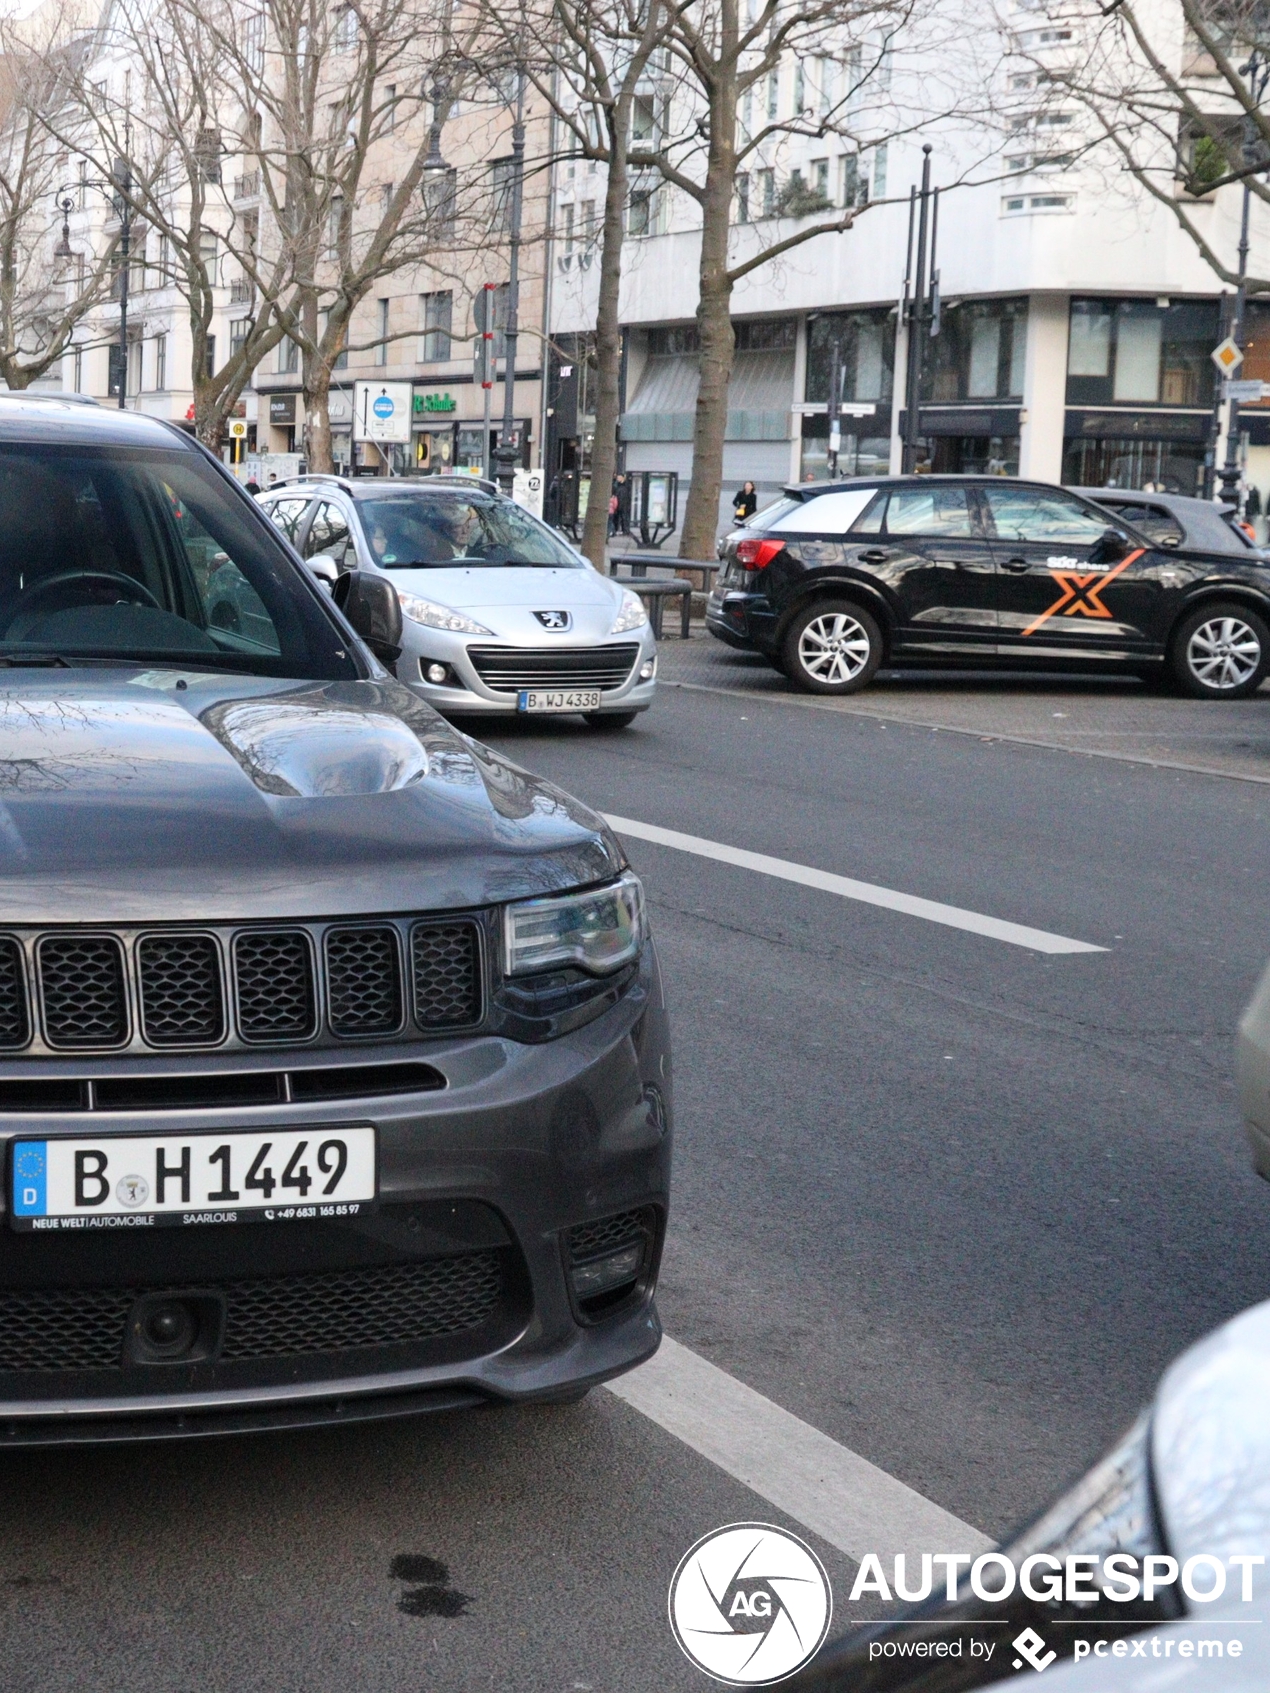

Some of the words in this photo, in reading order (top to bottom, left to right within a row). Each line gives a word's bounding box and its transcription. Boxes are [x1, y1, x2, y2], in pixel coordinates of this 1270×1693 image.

[1077, 561, 1110, 572] share
[528, 694, 537, 707] B
[546, 693, 564, 707] WJ
[566, 692, 599, 706] 4338
[74, 1149, 111, 1207] B
[23, 1188, 37, 1205] D
[277, 1208, 294, 1218] +49
[296, 1207, 316, 1217] 6831
[319, 1206, 334, 1216] 165
[335, 1205, 348, 1215] 85
[348, 1204, 360, 1214] 97
[32, 1219, 59, 1229] NEUE
[182, 1212, 237, 1224] SAARLOUIS
